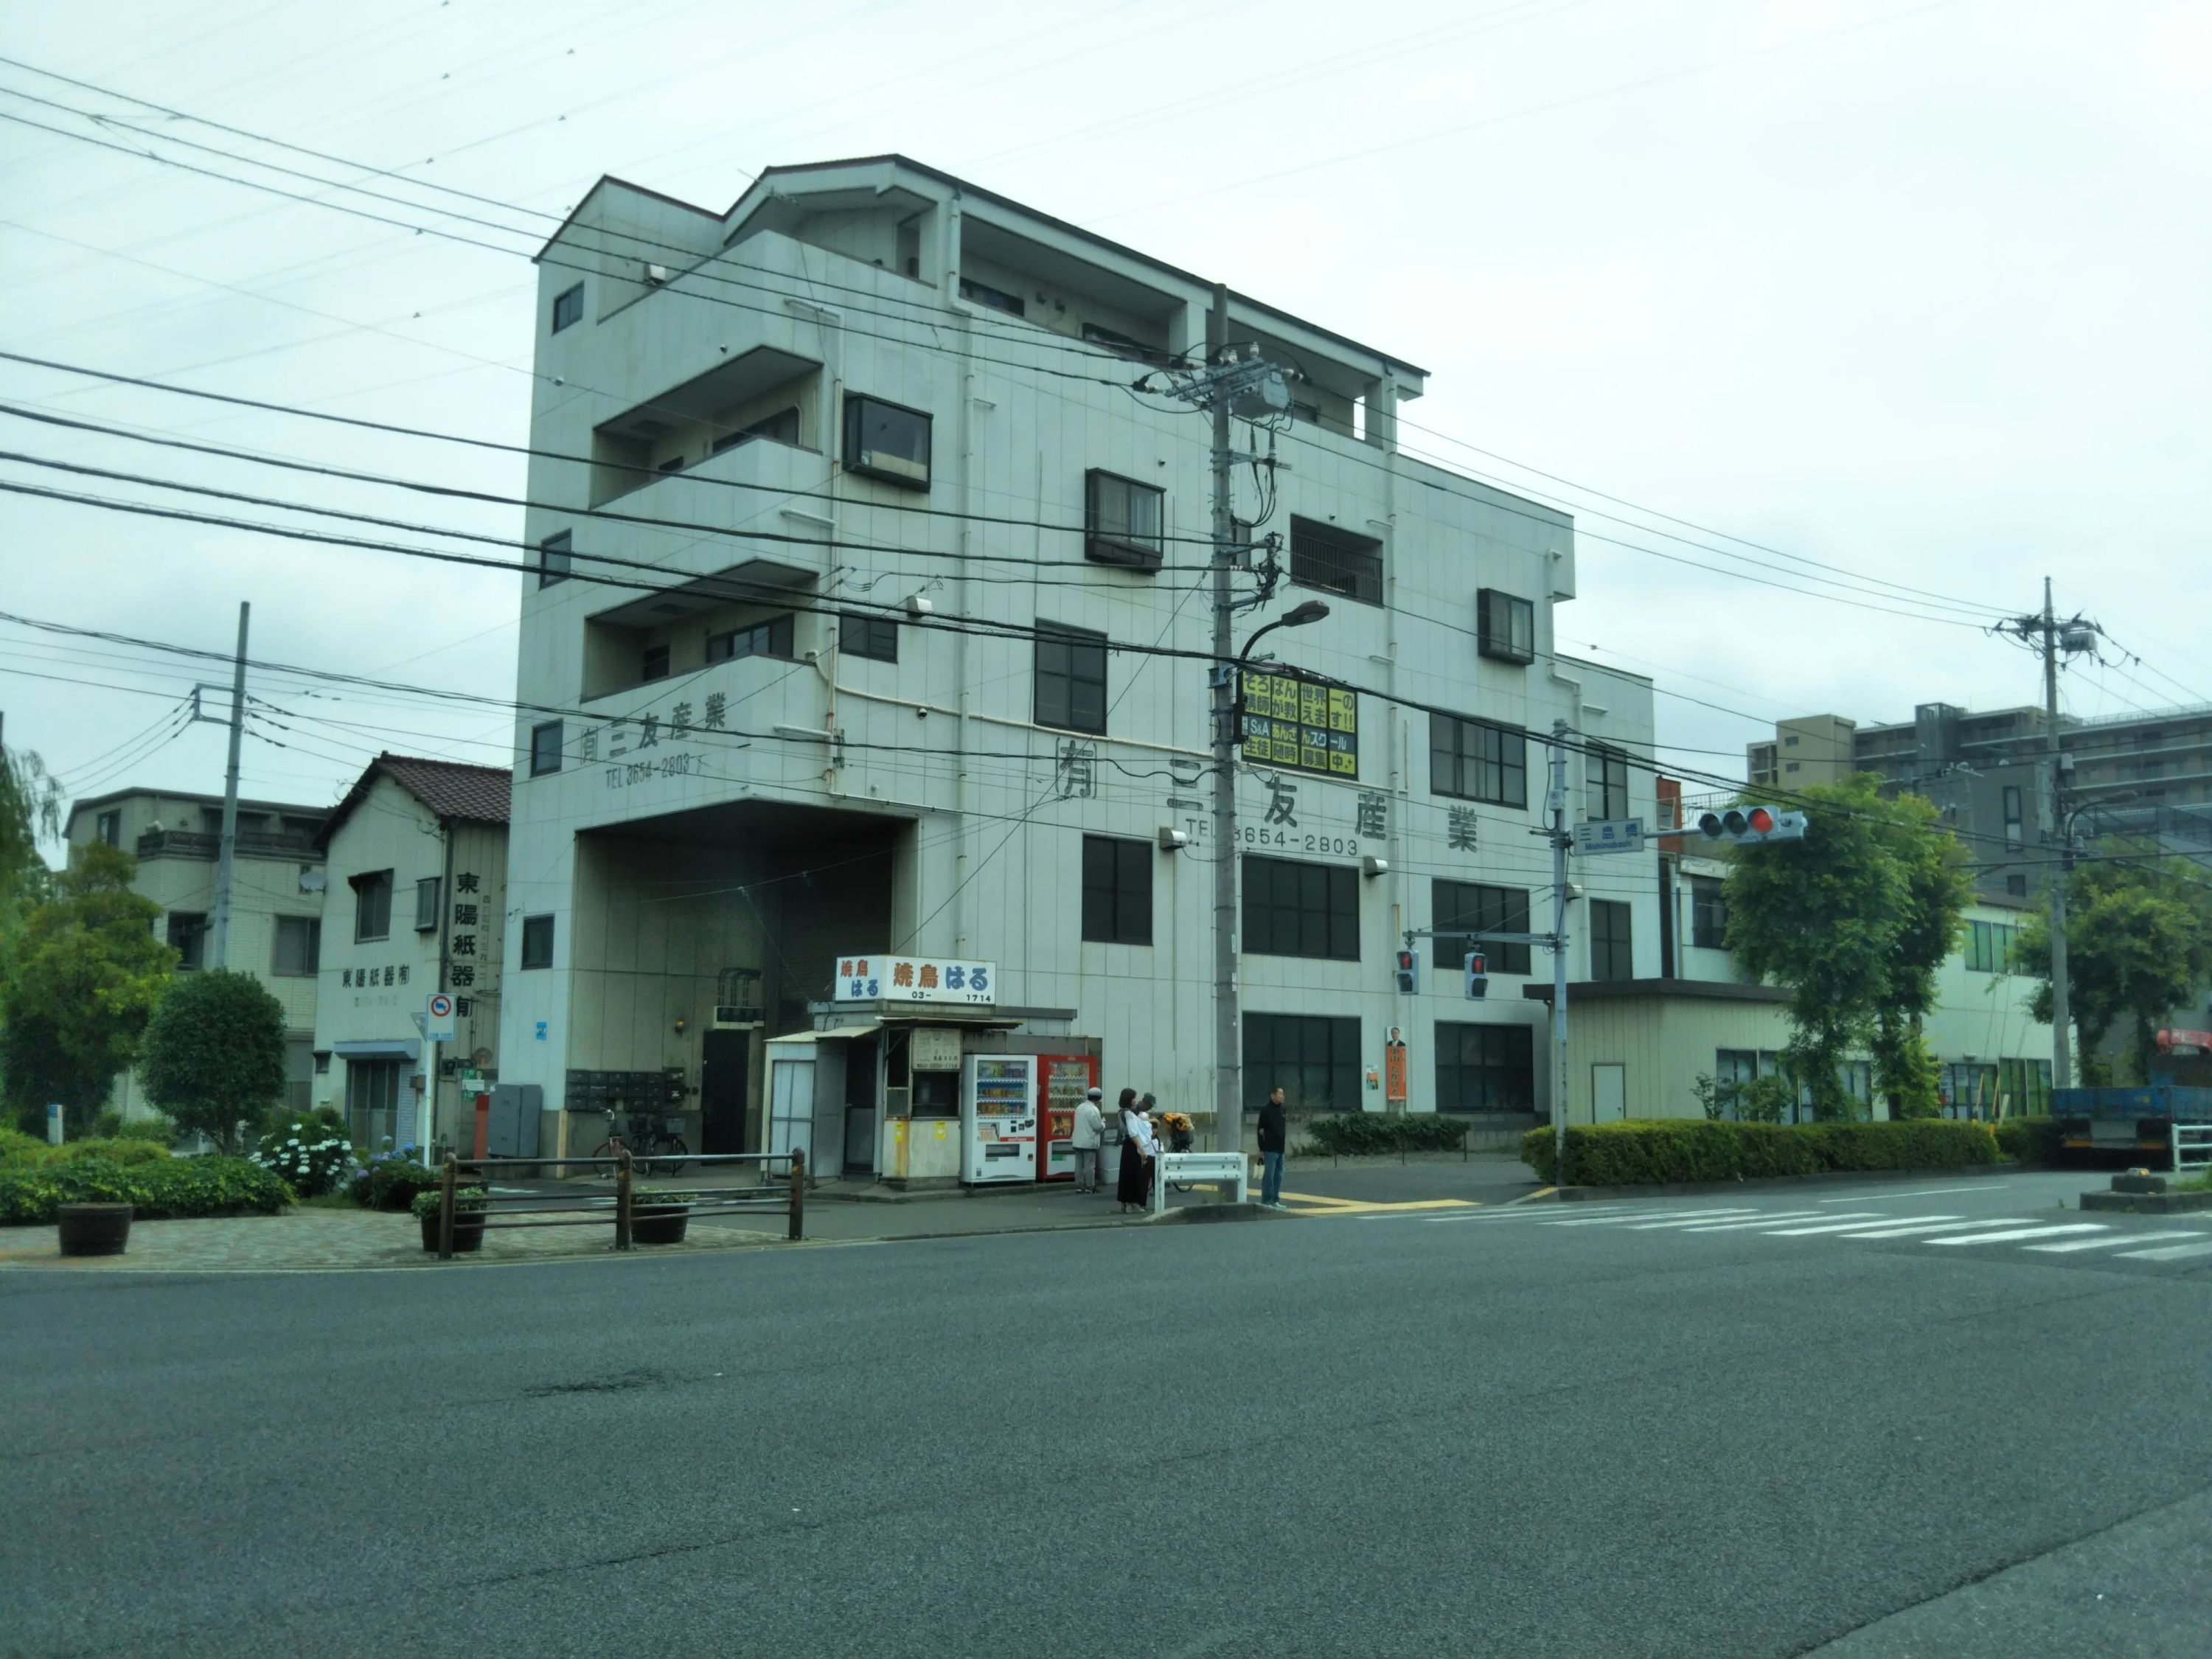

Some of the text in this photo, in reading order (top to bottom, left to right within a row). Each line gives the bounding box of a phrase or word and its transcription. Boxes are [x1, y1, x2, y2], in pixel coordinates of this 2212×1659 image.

[606, 753, 689, 790] TEL 3654-2803
[1186, 818, 1216, 838] TE
[1585, 841, 1632, 850] Mishimabashi
[841, 959, 868, 978] 焼鳥
[851, 979, 878, 997] はる
[967, 994, 991, 1002] 1714
